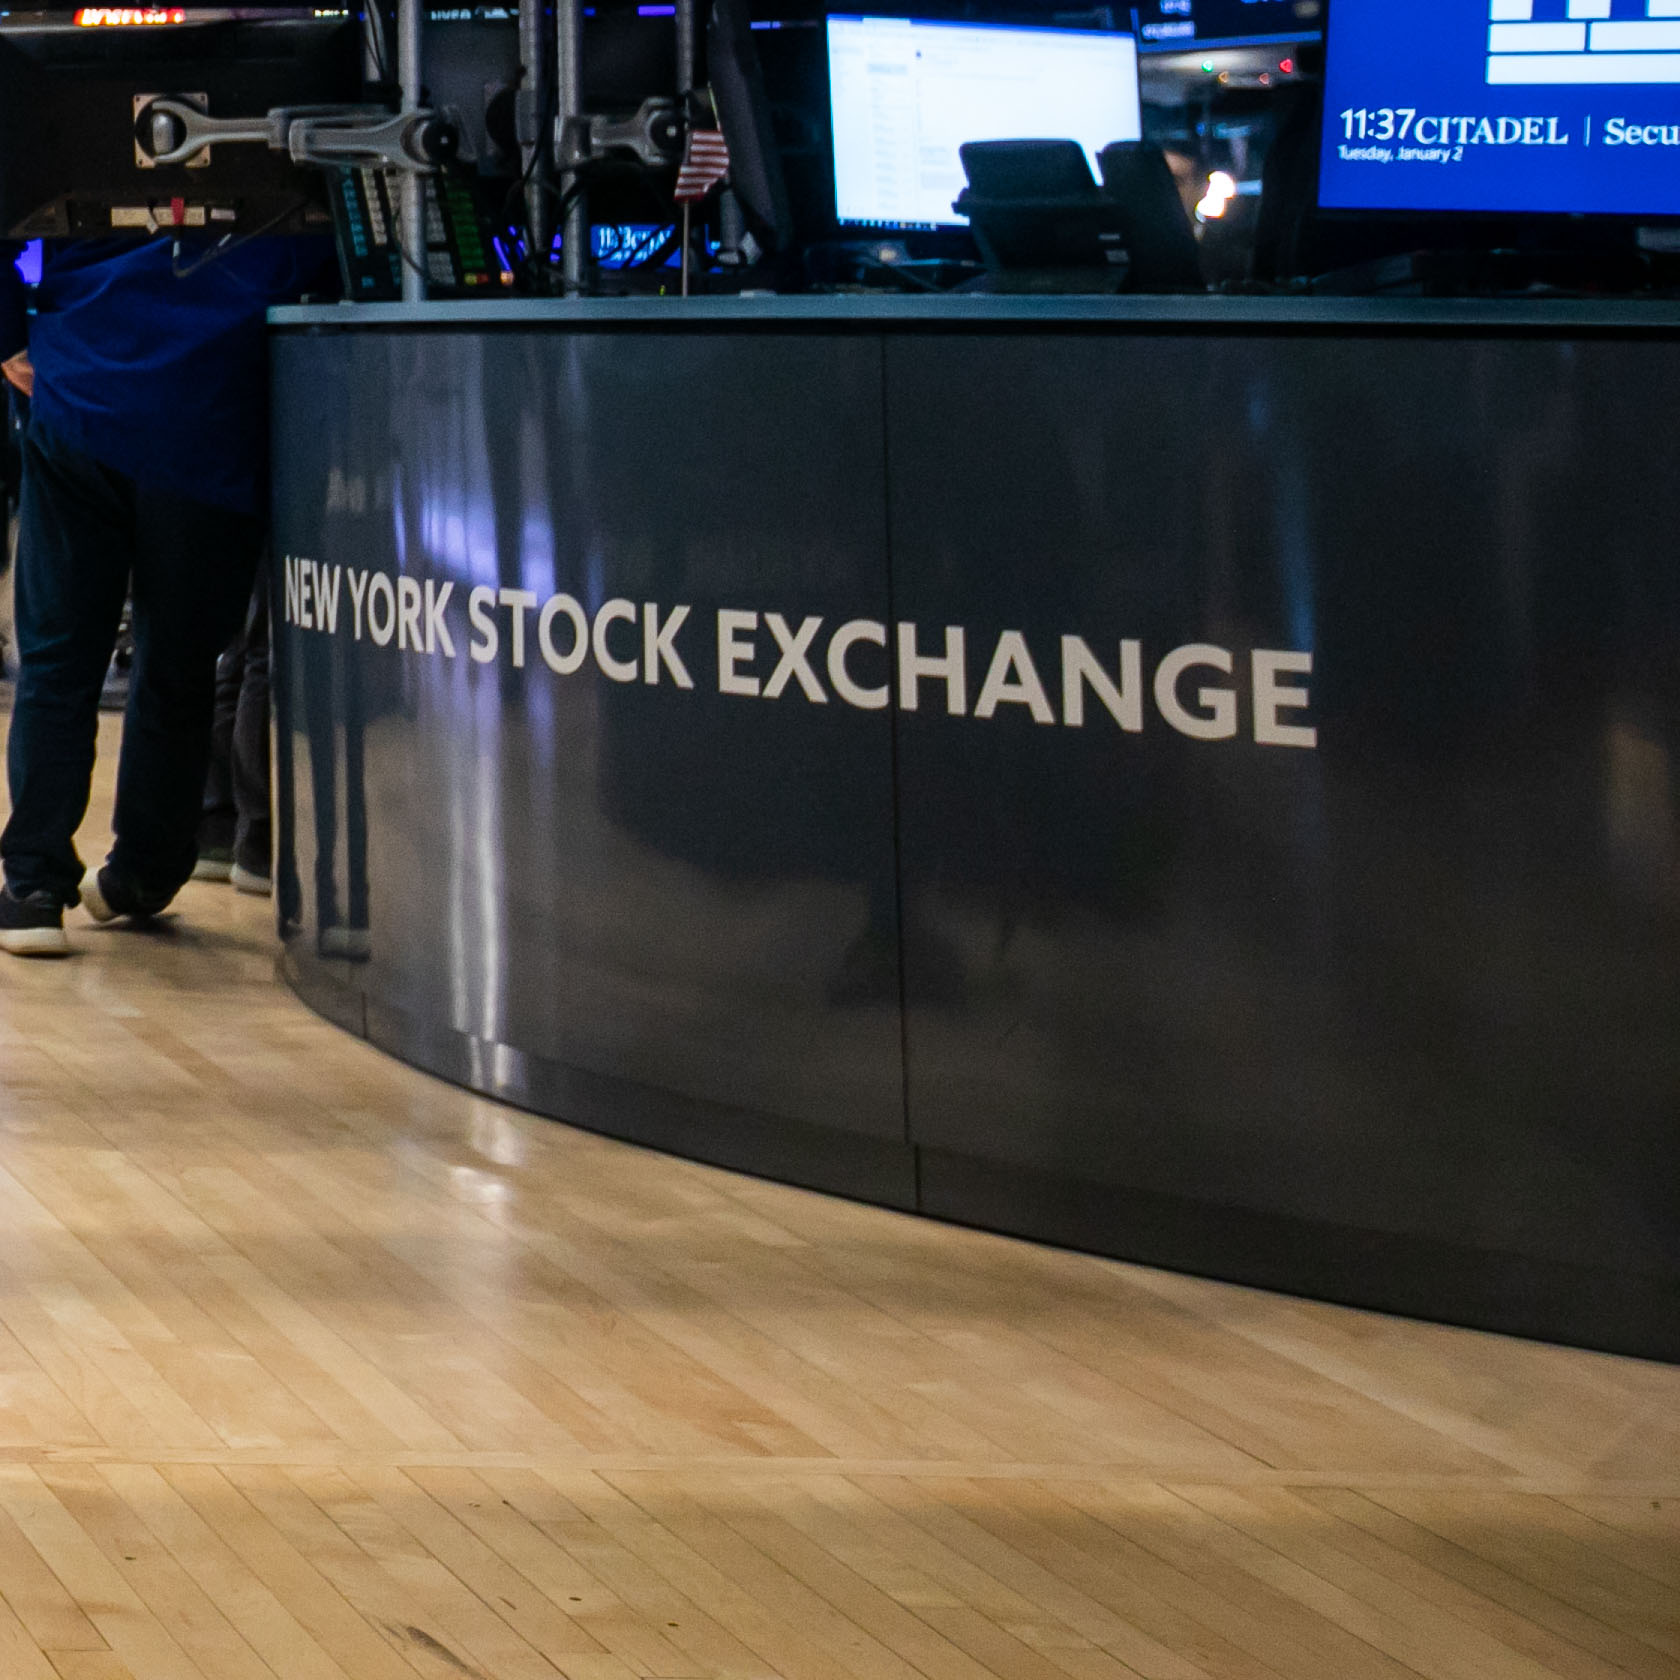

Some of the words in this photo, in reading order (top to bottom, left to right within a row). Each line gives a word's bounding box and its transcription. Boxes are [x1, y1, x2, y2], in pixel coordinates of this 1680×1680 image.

[1339, 107, 1417, 141] 11:37
[1413, 116, 1569, 146] CITADEL
[1337, 145, 1394, 164] Tuesday,
[1395, 145, 1451, 165] January
[1451, 145, 1464, 163] 2
[285, 554, 342, 634] NEW
[346, 569, 456, 658] YORK
[468, 586, 695, 691] STOCK
[717, 609, 1318, 749] EXCHANGE
